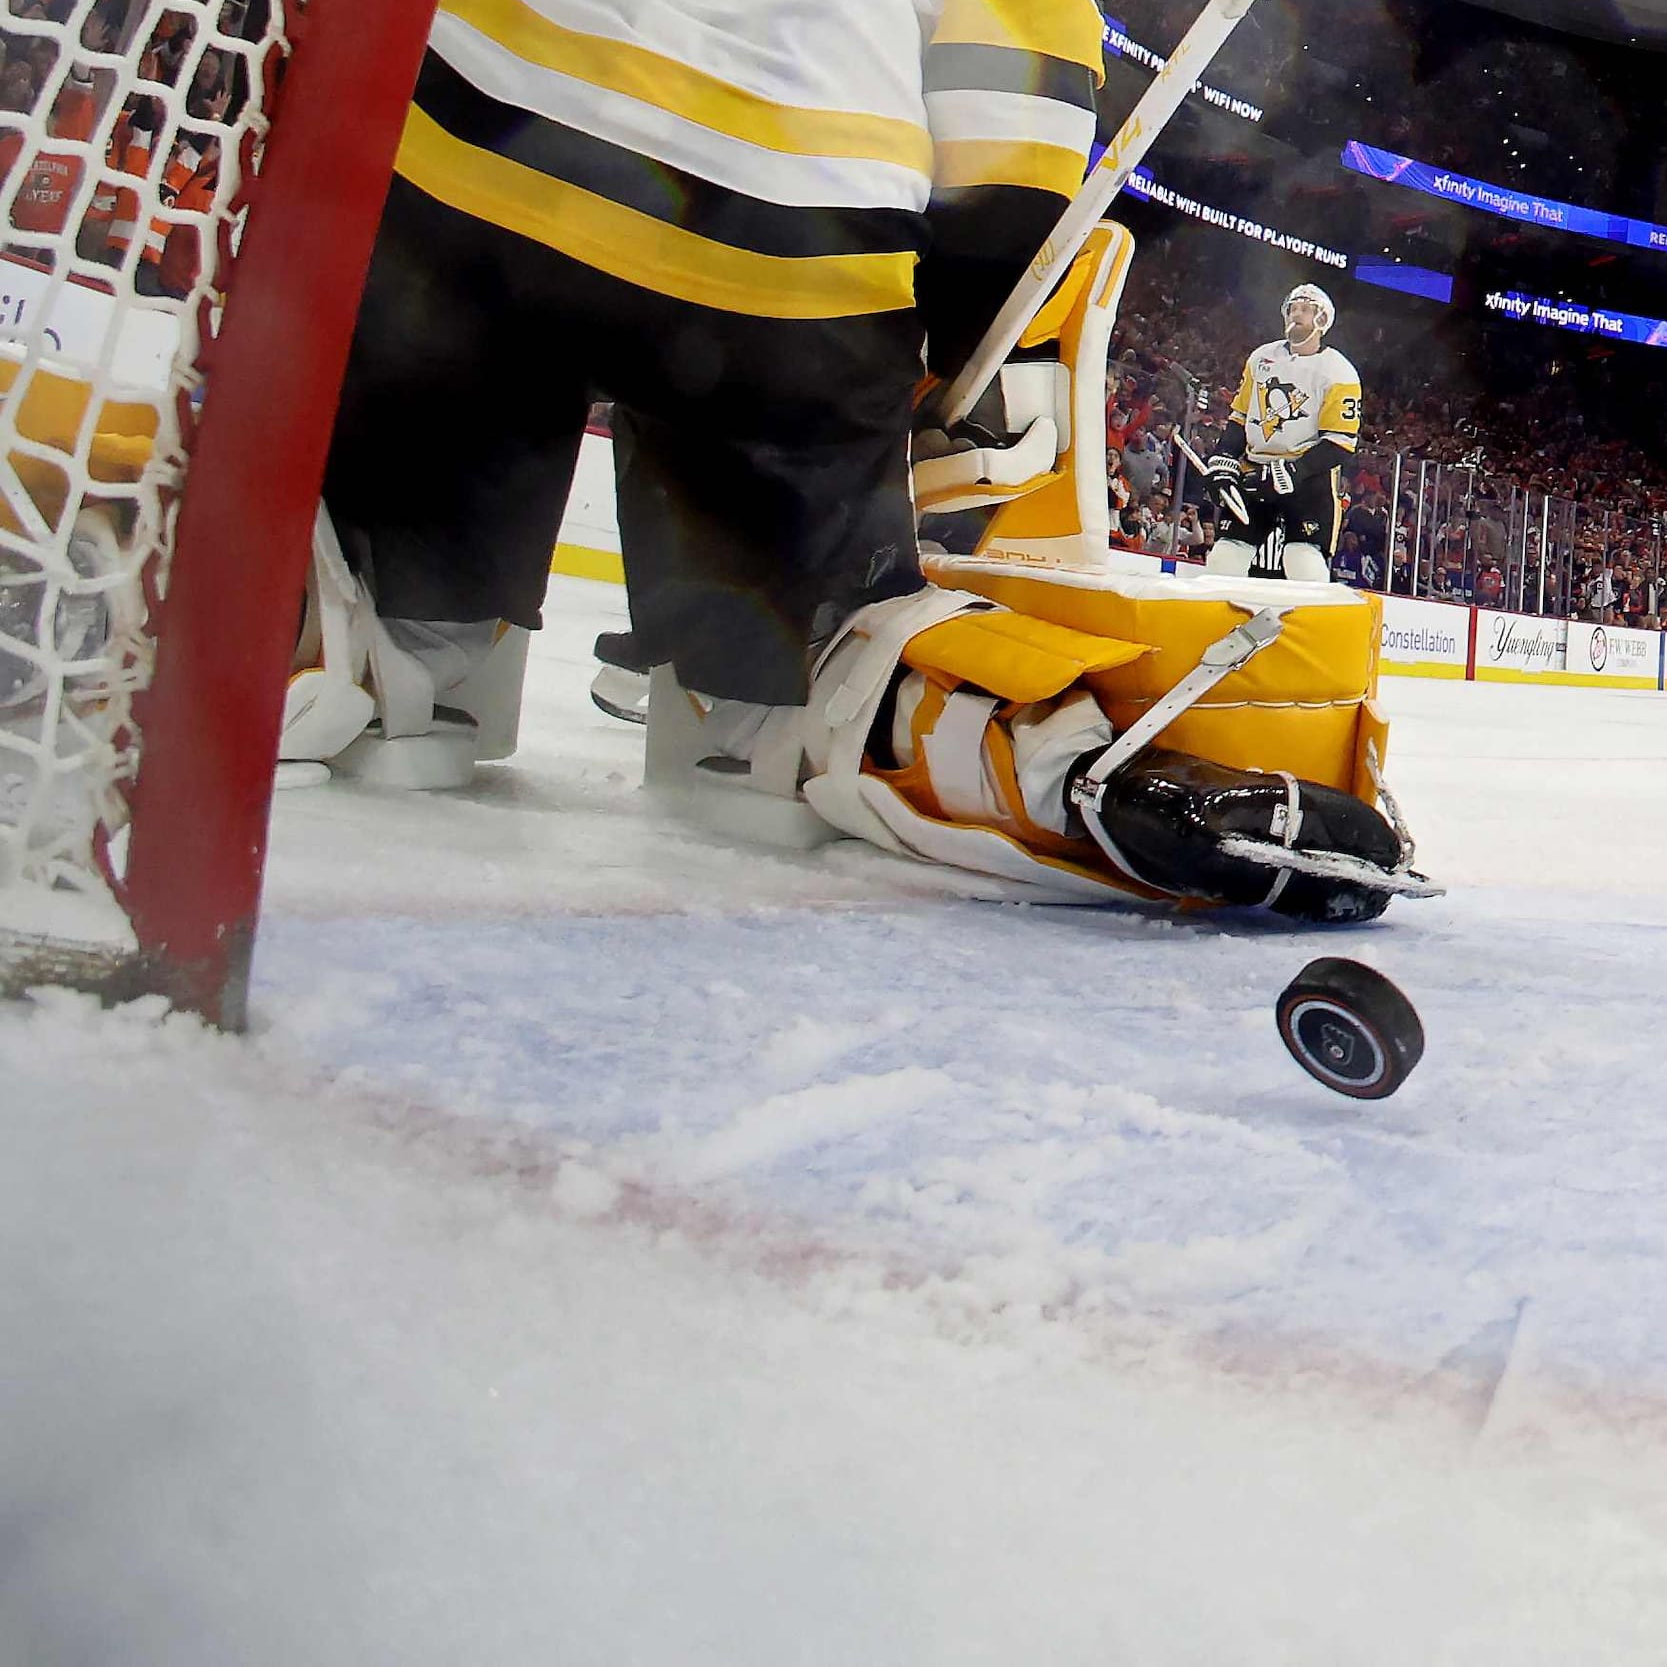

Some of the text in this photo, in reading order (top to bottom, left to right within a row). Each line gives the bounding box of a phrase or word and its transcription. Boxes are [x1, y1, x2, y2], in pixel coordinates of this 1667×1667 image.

[1109, 29, 1152, 67] XFINITY
[1203, 85, 1230, 111] WIFI
[1230, 99, 1264, 123] NOW
[1128, 172, 1348, 268] RELIABLE WIFI BUILT FOR PLAYOFF RUNS
[1433, 173, 1564, 223] xfinity Imagine That
[1485, 291, 1623, 333] xfinity Imagine That
[1380, 623, 1456, 654] Constellation
[1489, 615, 1558, 666] Yuengling
[1624, 638, 1648, 657] WEBB
